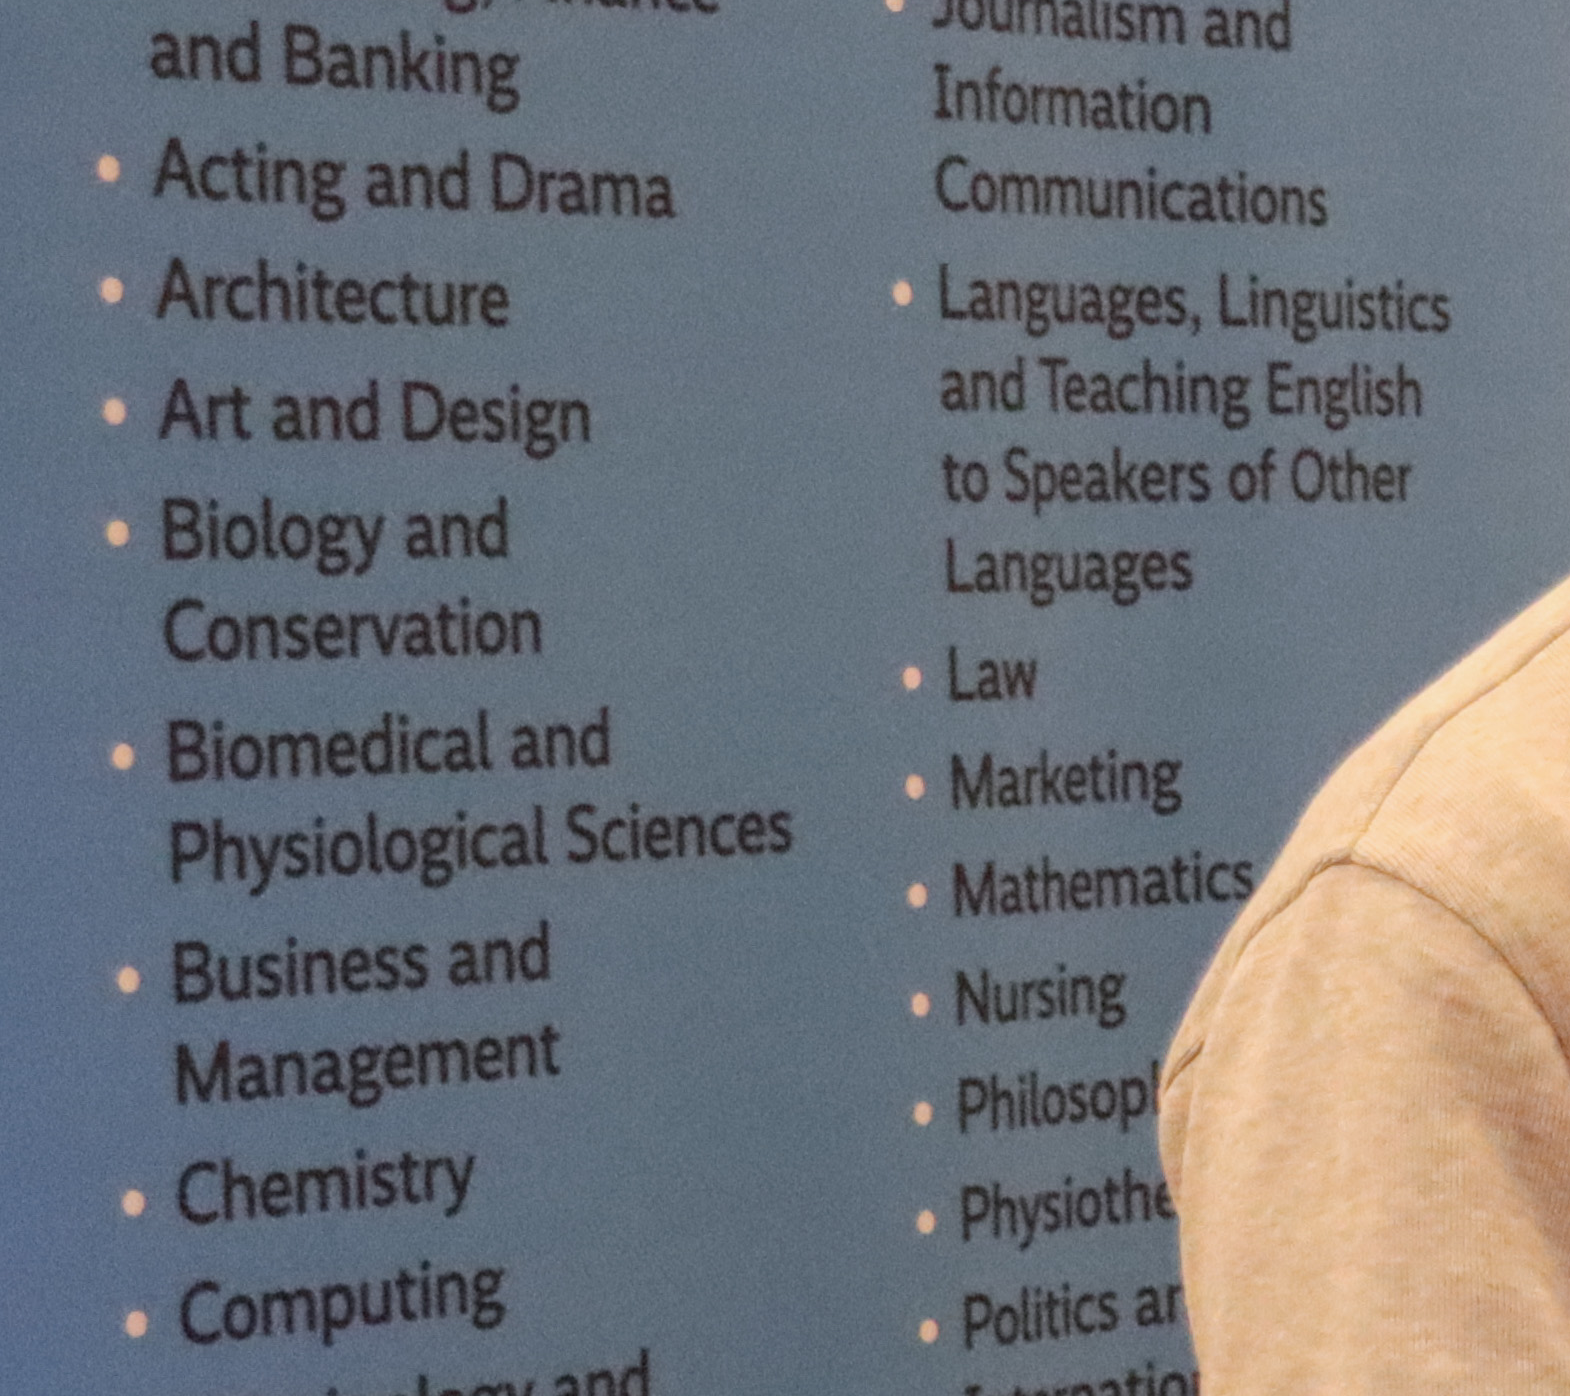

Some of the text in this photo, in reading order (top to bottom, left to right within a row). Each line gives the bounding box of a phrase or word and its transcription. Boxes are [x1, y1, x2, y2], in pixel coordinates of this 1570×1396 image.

[149, 20, 520, 114] and Banking
[933, 62, 1212, 134] Information
[153, 137, 676, 223] Acting and Drama
[935, 154, 1327, 227] Communications
[156, 257, 509, 328] Architecture
[939, 264, 1451, 344] Languages, Linguistics
[159, 378, 590, 461] Art and Design
[941, 356, 1422, 432] and Teaching English
[942, 446, 1412, 516] to Speakers of Other
[162, 496, 508, 576] Biology and
[946, 538, 1193, 608] Languages
[163, 597, 541, 662] Conservation
[948, 646, 1037, 702] Law
[168, 707, 610, 783] Biomedical and
[951, 749, 1182, 816] Marketing
[170, 803, 793, 897] Physiological Sciences
[953, 850, 1254, 916] Mathematics
[173, 919, 550, 1005] Business and
[956, 963, 1126, 1029] Nursing
[175, 1025, 560, 1109] Management
[176, 1149, 475, 1225] Chemistry
[960, 1168, 1179, 1248] Physiothe
[180, 1260, 506, 1347] Computing
[963, 1280, 1119, 1349] Politics
